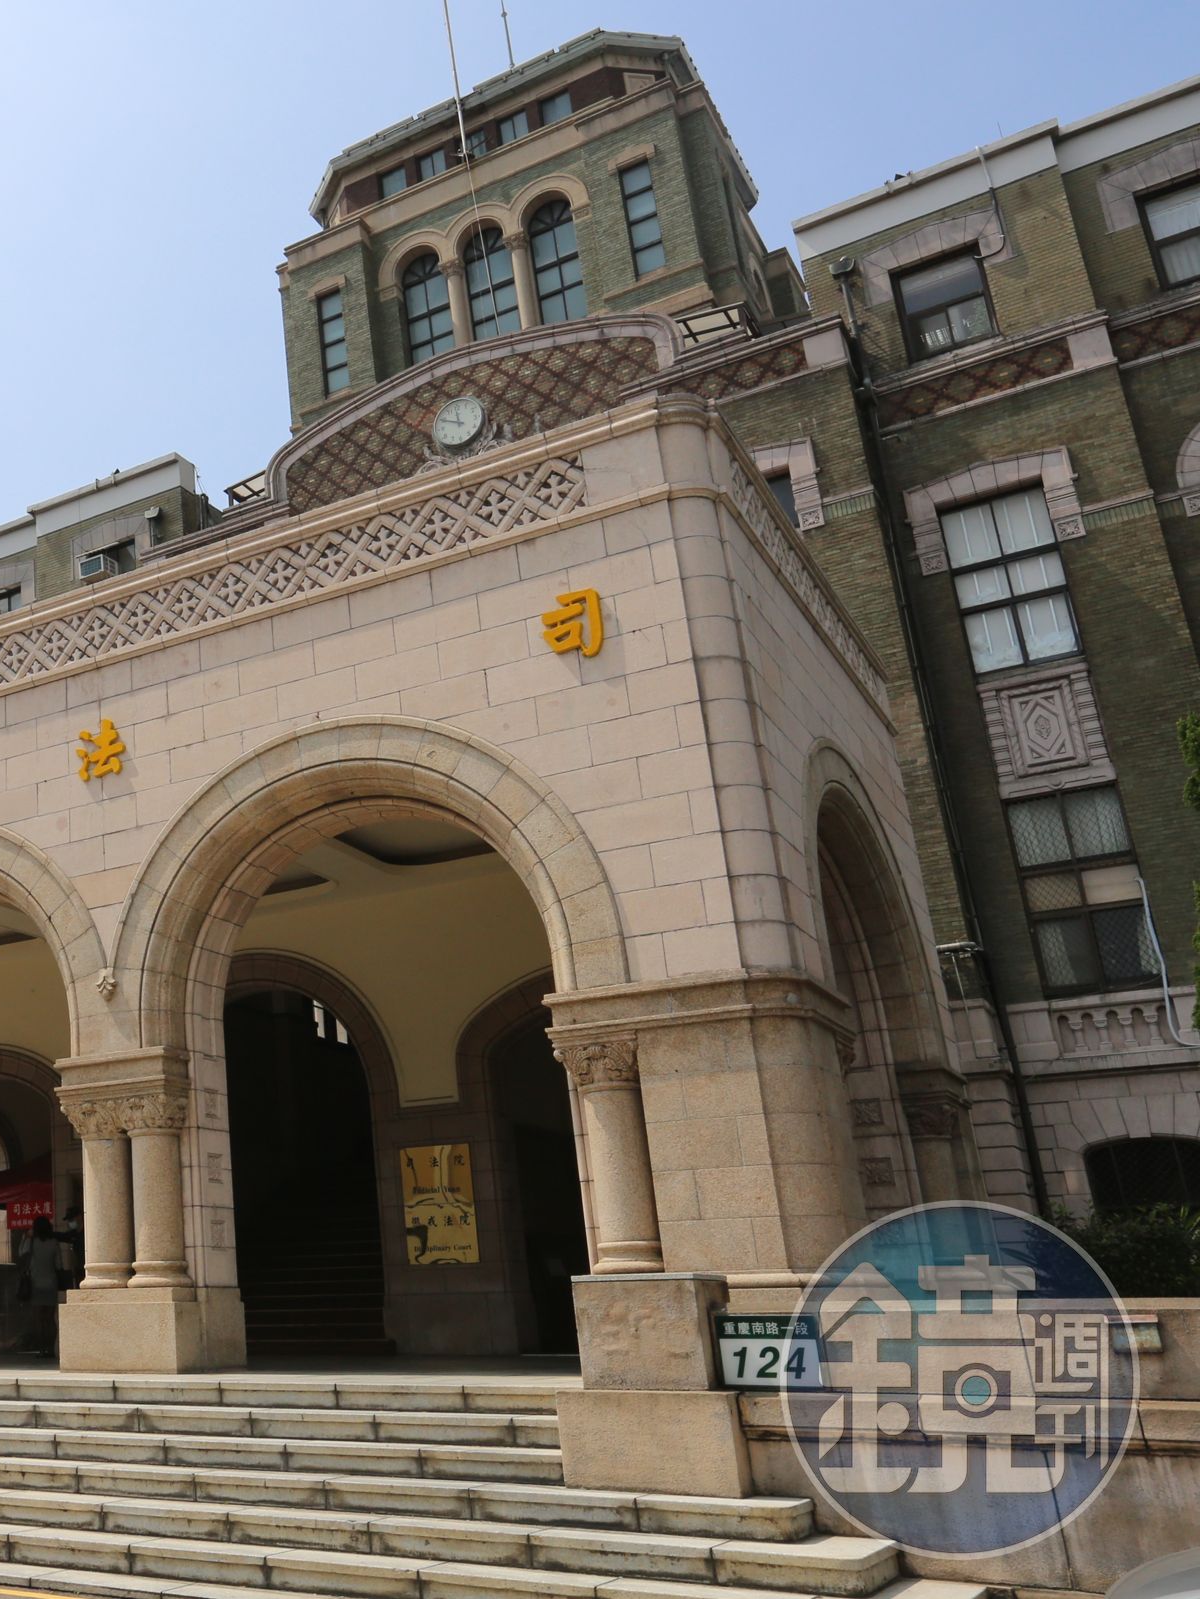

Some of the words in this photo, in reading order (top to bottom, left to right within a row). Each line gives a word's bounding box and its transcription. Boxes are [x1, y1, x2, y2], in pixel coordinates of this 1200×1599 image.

[723, 1321, 809, 1336] 重慶南路一段
[732, 1345, 806, 1380] 124
